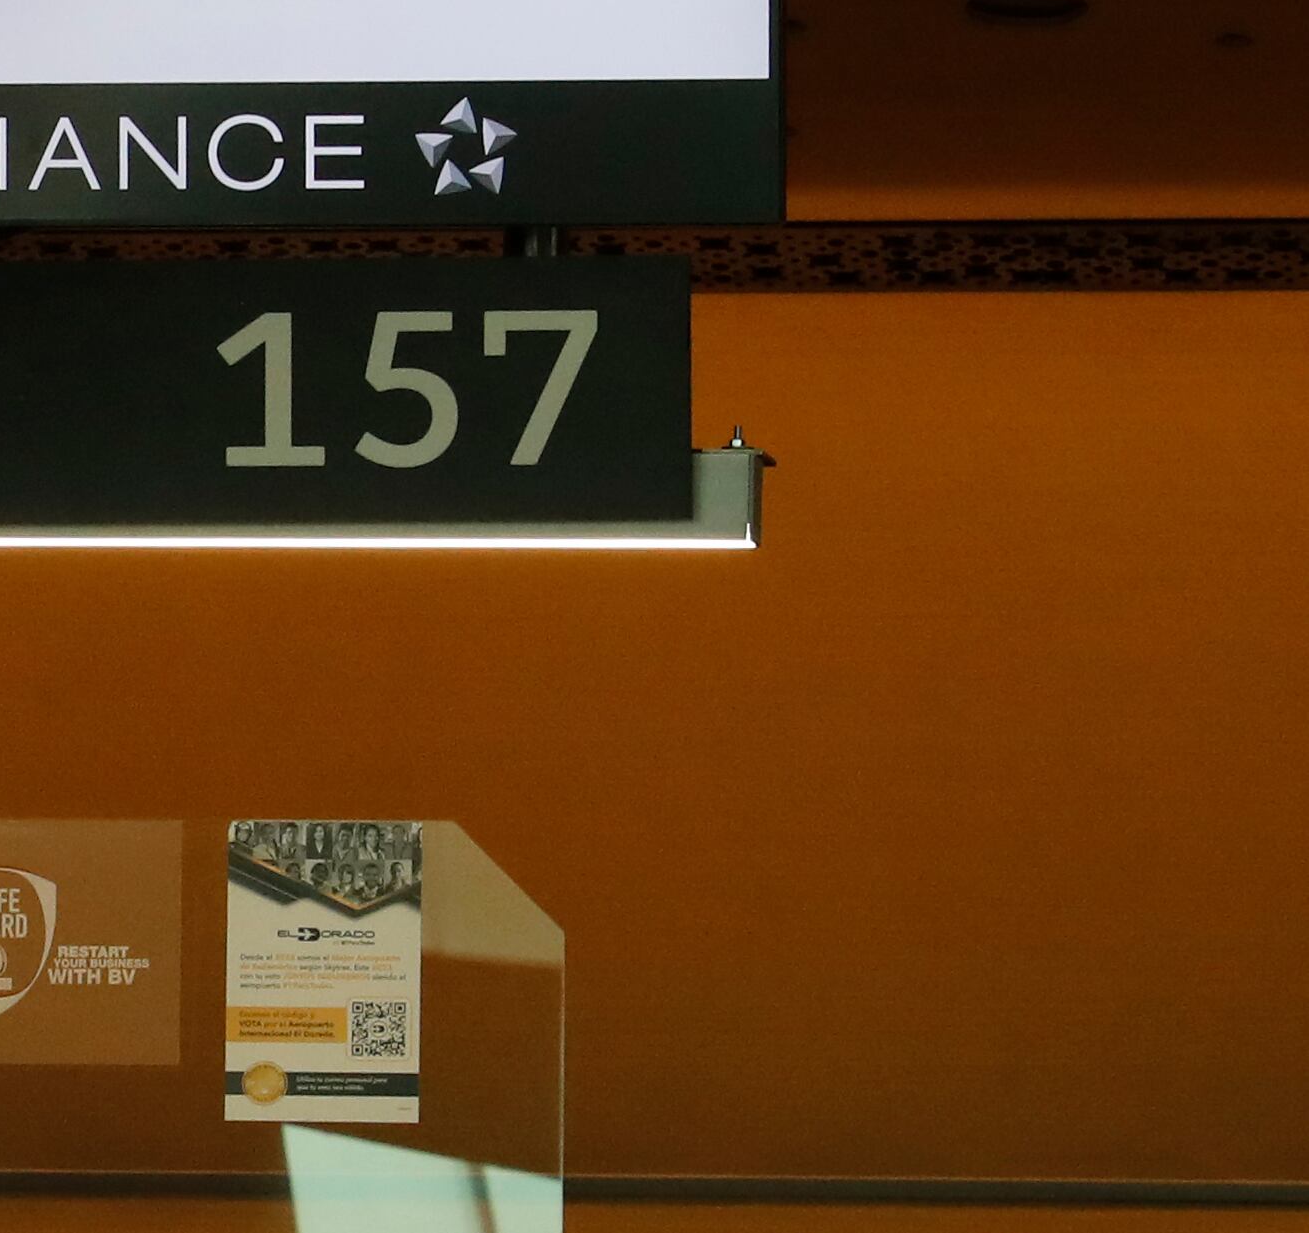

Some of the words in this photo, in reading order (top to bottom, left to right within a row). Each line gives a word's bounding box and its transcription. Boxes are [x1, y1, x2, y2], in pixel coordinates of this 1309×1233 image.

[216, 310, 598, 468] 157
[57, 946, 130, 959] RESTART
[54, 958, 87, 969] YOUR
[89, 958, 150, 969] BUSINESS
[47, 968, 101, 985] WITH
[108, 968, 136, 985] BV
